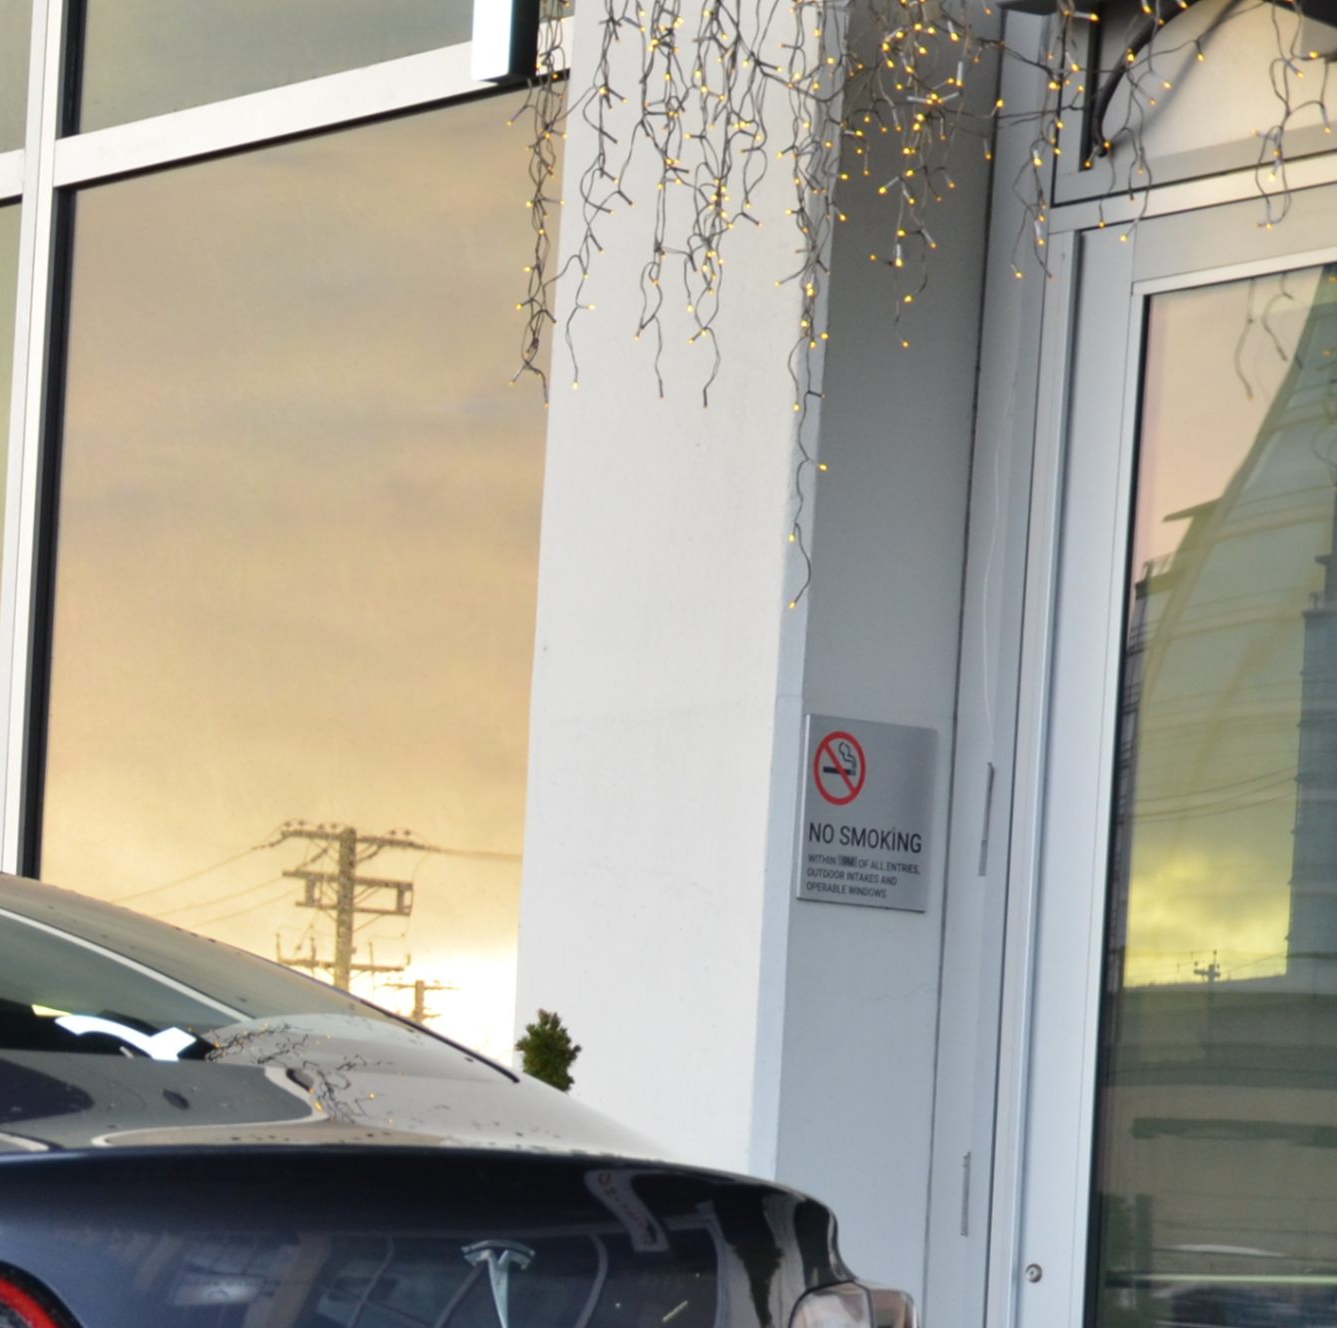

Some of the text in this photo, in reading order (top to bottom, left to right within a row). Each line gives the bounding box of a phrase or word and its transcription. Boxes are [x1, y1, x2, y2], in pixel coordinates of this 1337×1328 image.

[809, 822, 922, 854] NO SMOKING
[808, 854, 836, 866] WITHIN
[859, 859, 869, 868] OF
[870, 861, 886, 871] ALL
[807, 867, 898, 886] OUTDOOR INTAKES AND
[806, 881, 887, 898] OPERABLE WINDOWS
